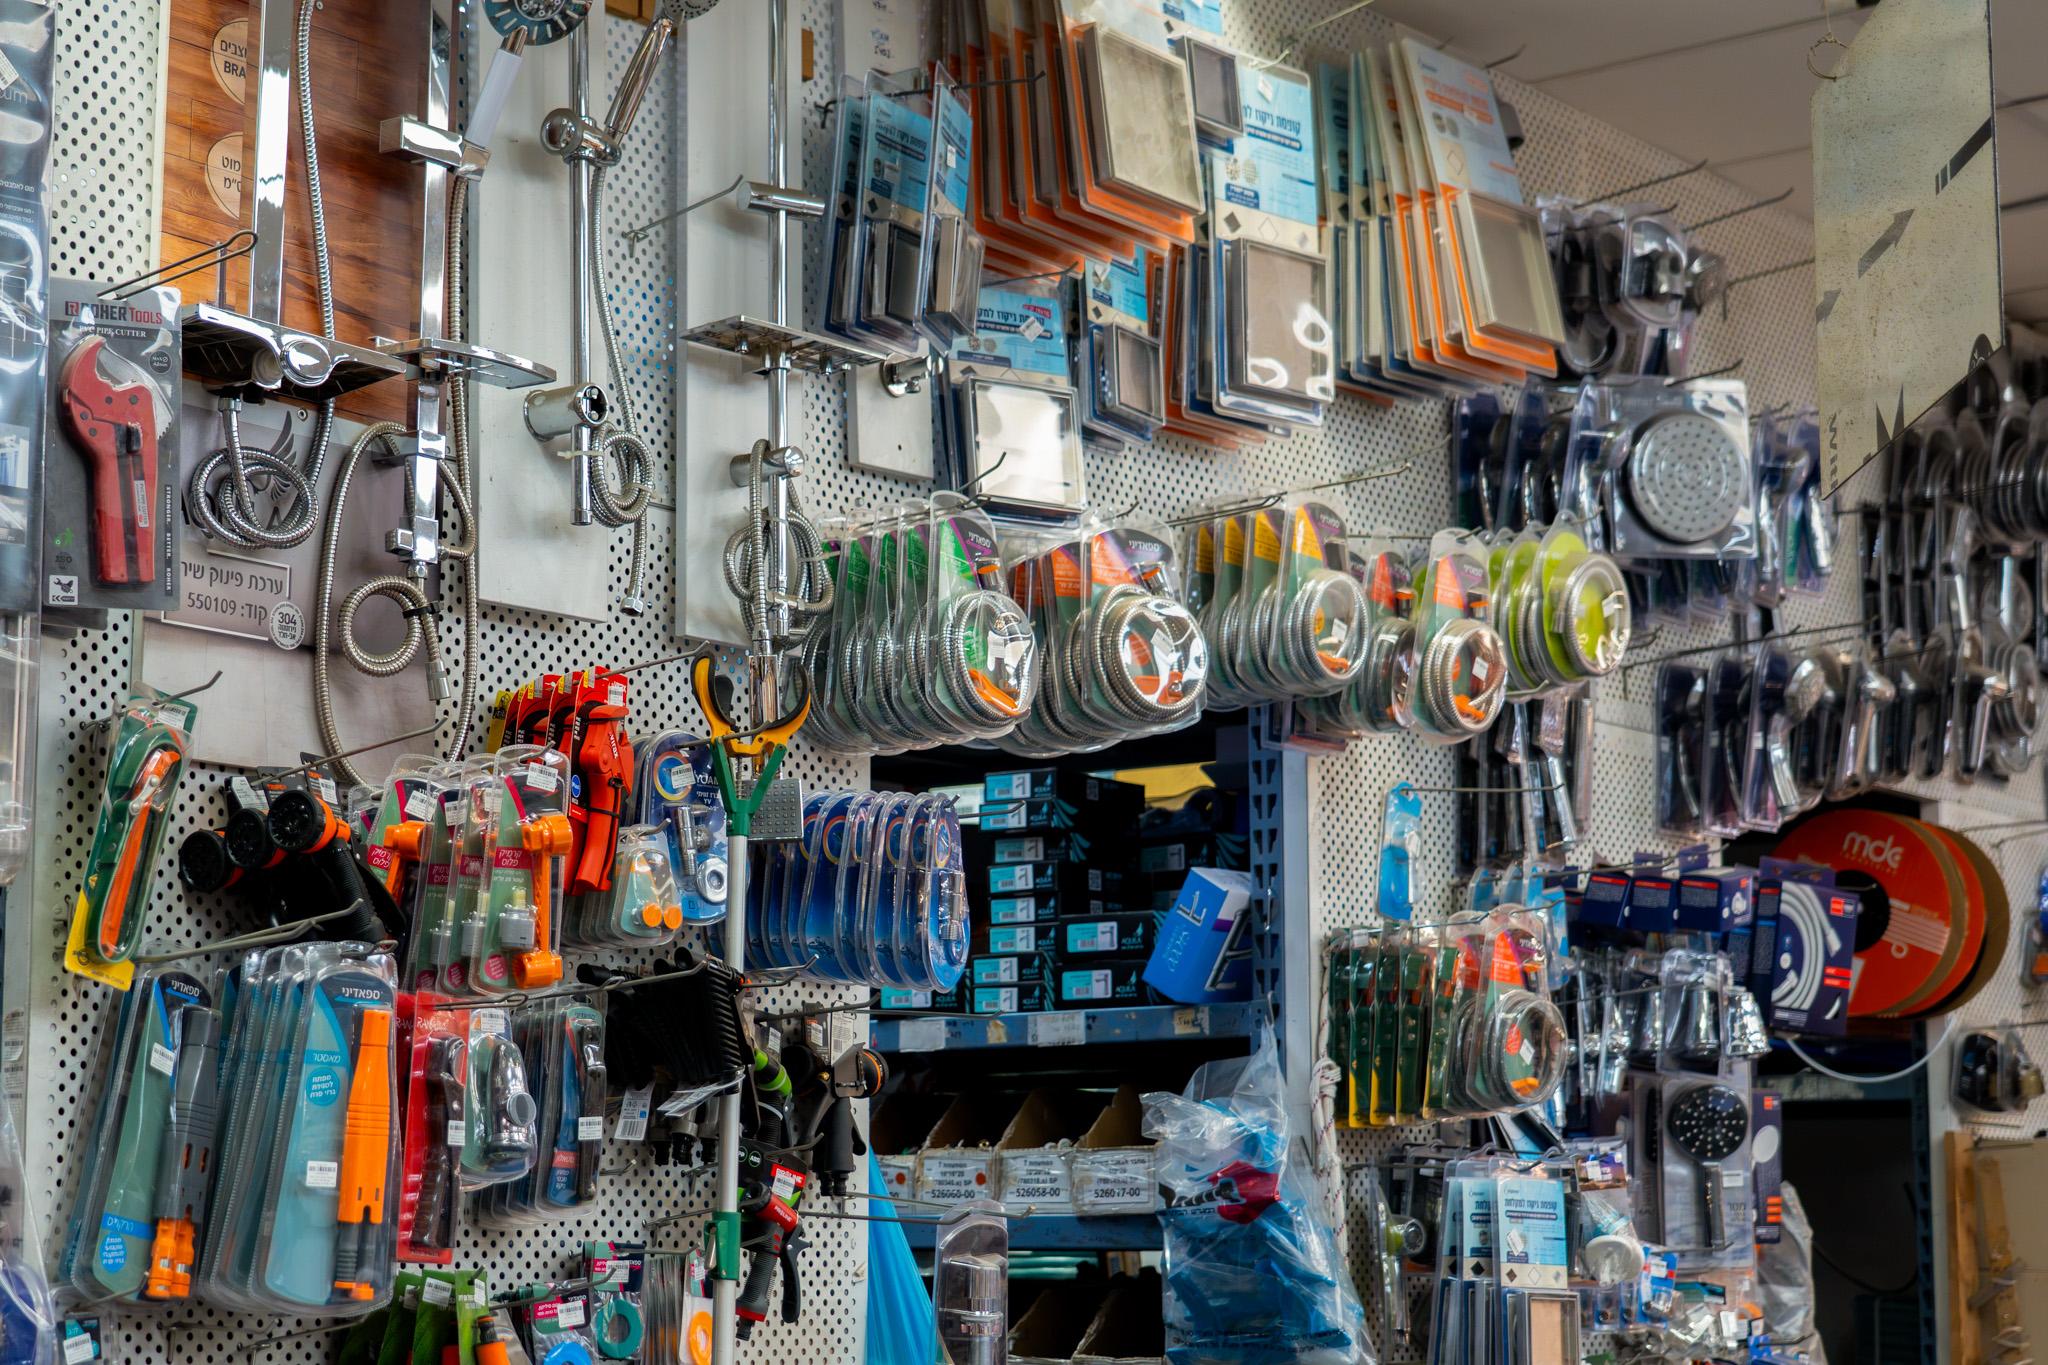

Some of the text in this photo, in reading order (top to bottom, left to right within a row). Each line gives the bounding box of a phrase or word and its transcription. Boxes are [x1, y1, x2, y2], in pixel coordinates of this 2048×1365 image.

[115, 329, 146, 338] CUTTER
[209, 566, 243, 588] פינוק
[248, 574, 283, 595] ערכת
[187, 592, 268, 626] קוד: 550109
[278, 611, 297, 625] 304
[171, 979, 201, 997] ספאדיני
[342, 986, 381, 1000] ספאדיני
